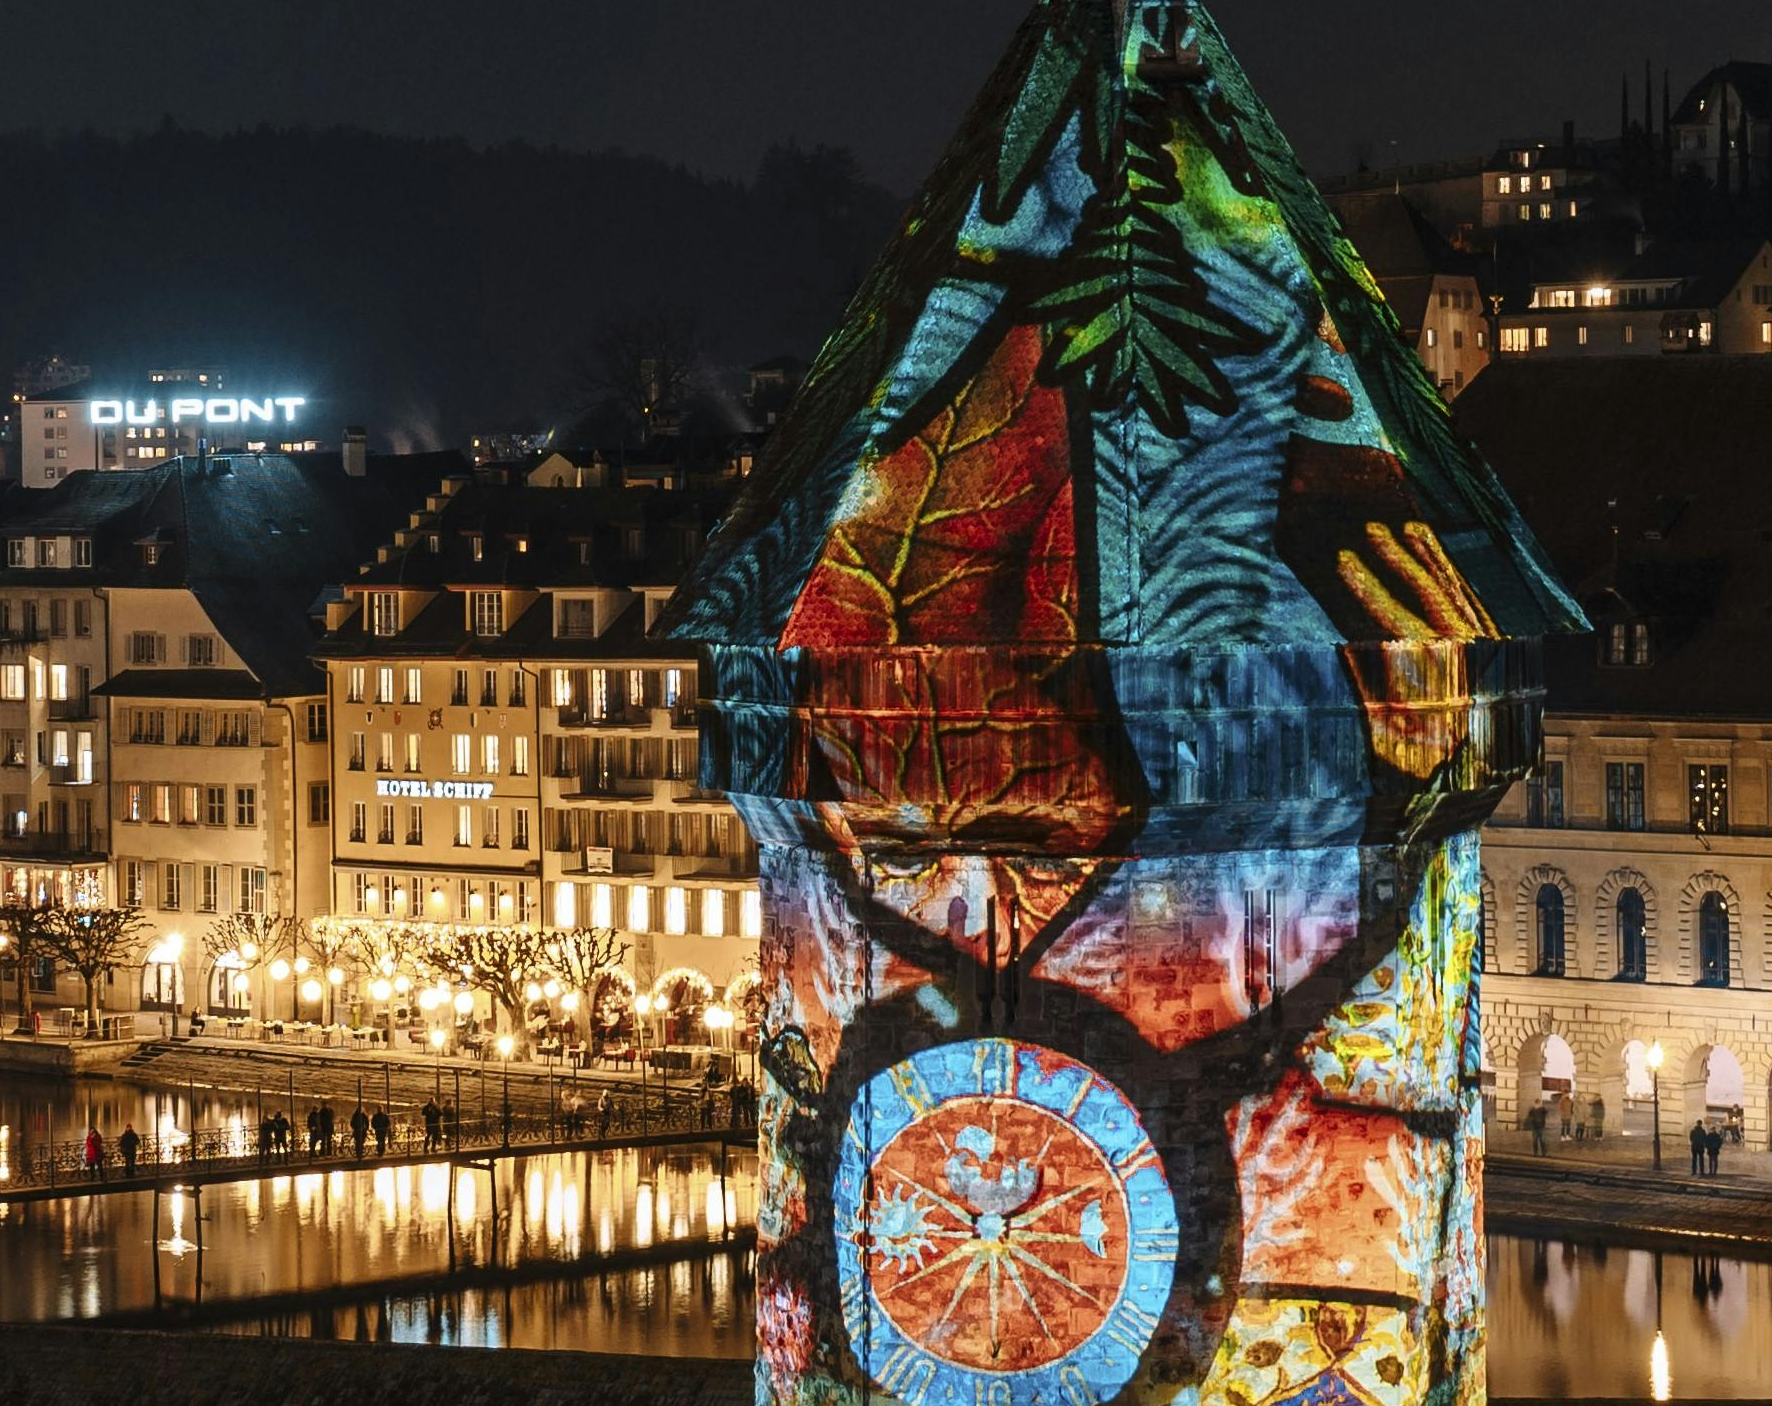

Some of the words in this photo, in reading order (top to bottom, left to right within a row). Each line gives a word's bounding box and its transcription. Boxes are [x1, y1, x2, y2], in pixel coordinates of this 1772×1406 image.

[90, 398, 157, 424] DU
[171, 397, 306, 423] PONT
[376, 779, 431, 798] HOTEL
[432, 781, 494, 800] SCHIFF
